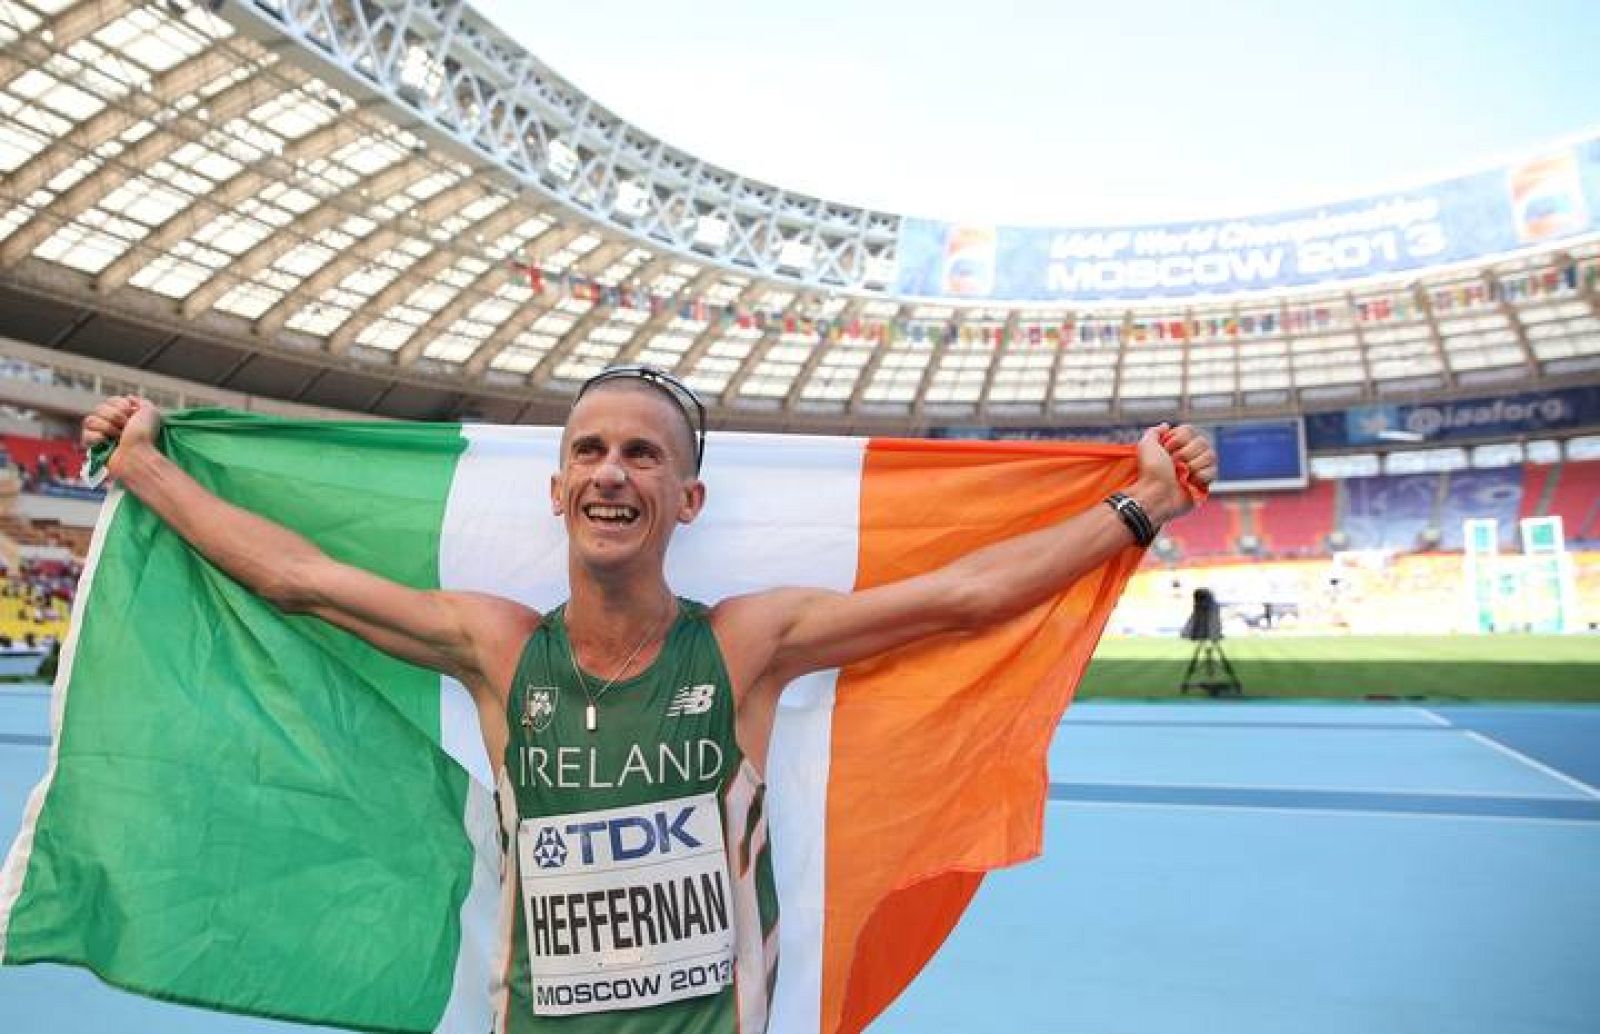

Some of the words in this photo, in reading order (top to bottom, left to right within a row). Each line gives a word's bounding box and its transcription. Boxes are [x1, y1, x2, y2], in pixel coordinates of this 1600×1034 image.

[1049, 248, 1283, 290] MOSCOW
[1298, 221, 1446, 272] 2013
[1135, 227, 1214, 254] World
[519, 740, 723, 788] IRELAND
[566, 806, 701, 865] TDK
[531, 872, 728, 956] HEFFERNAN
[537, 974, 661, 1006] MOSCOW
